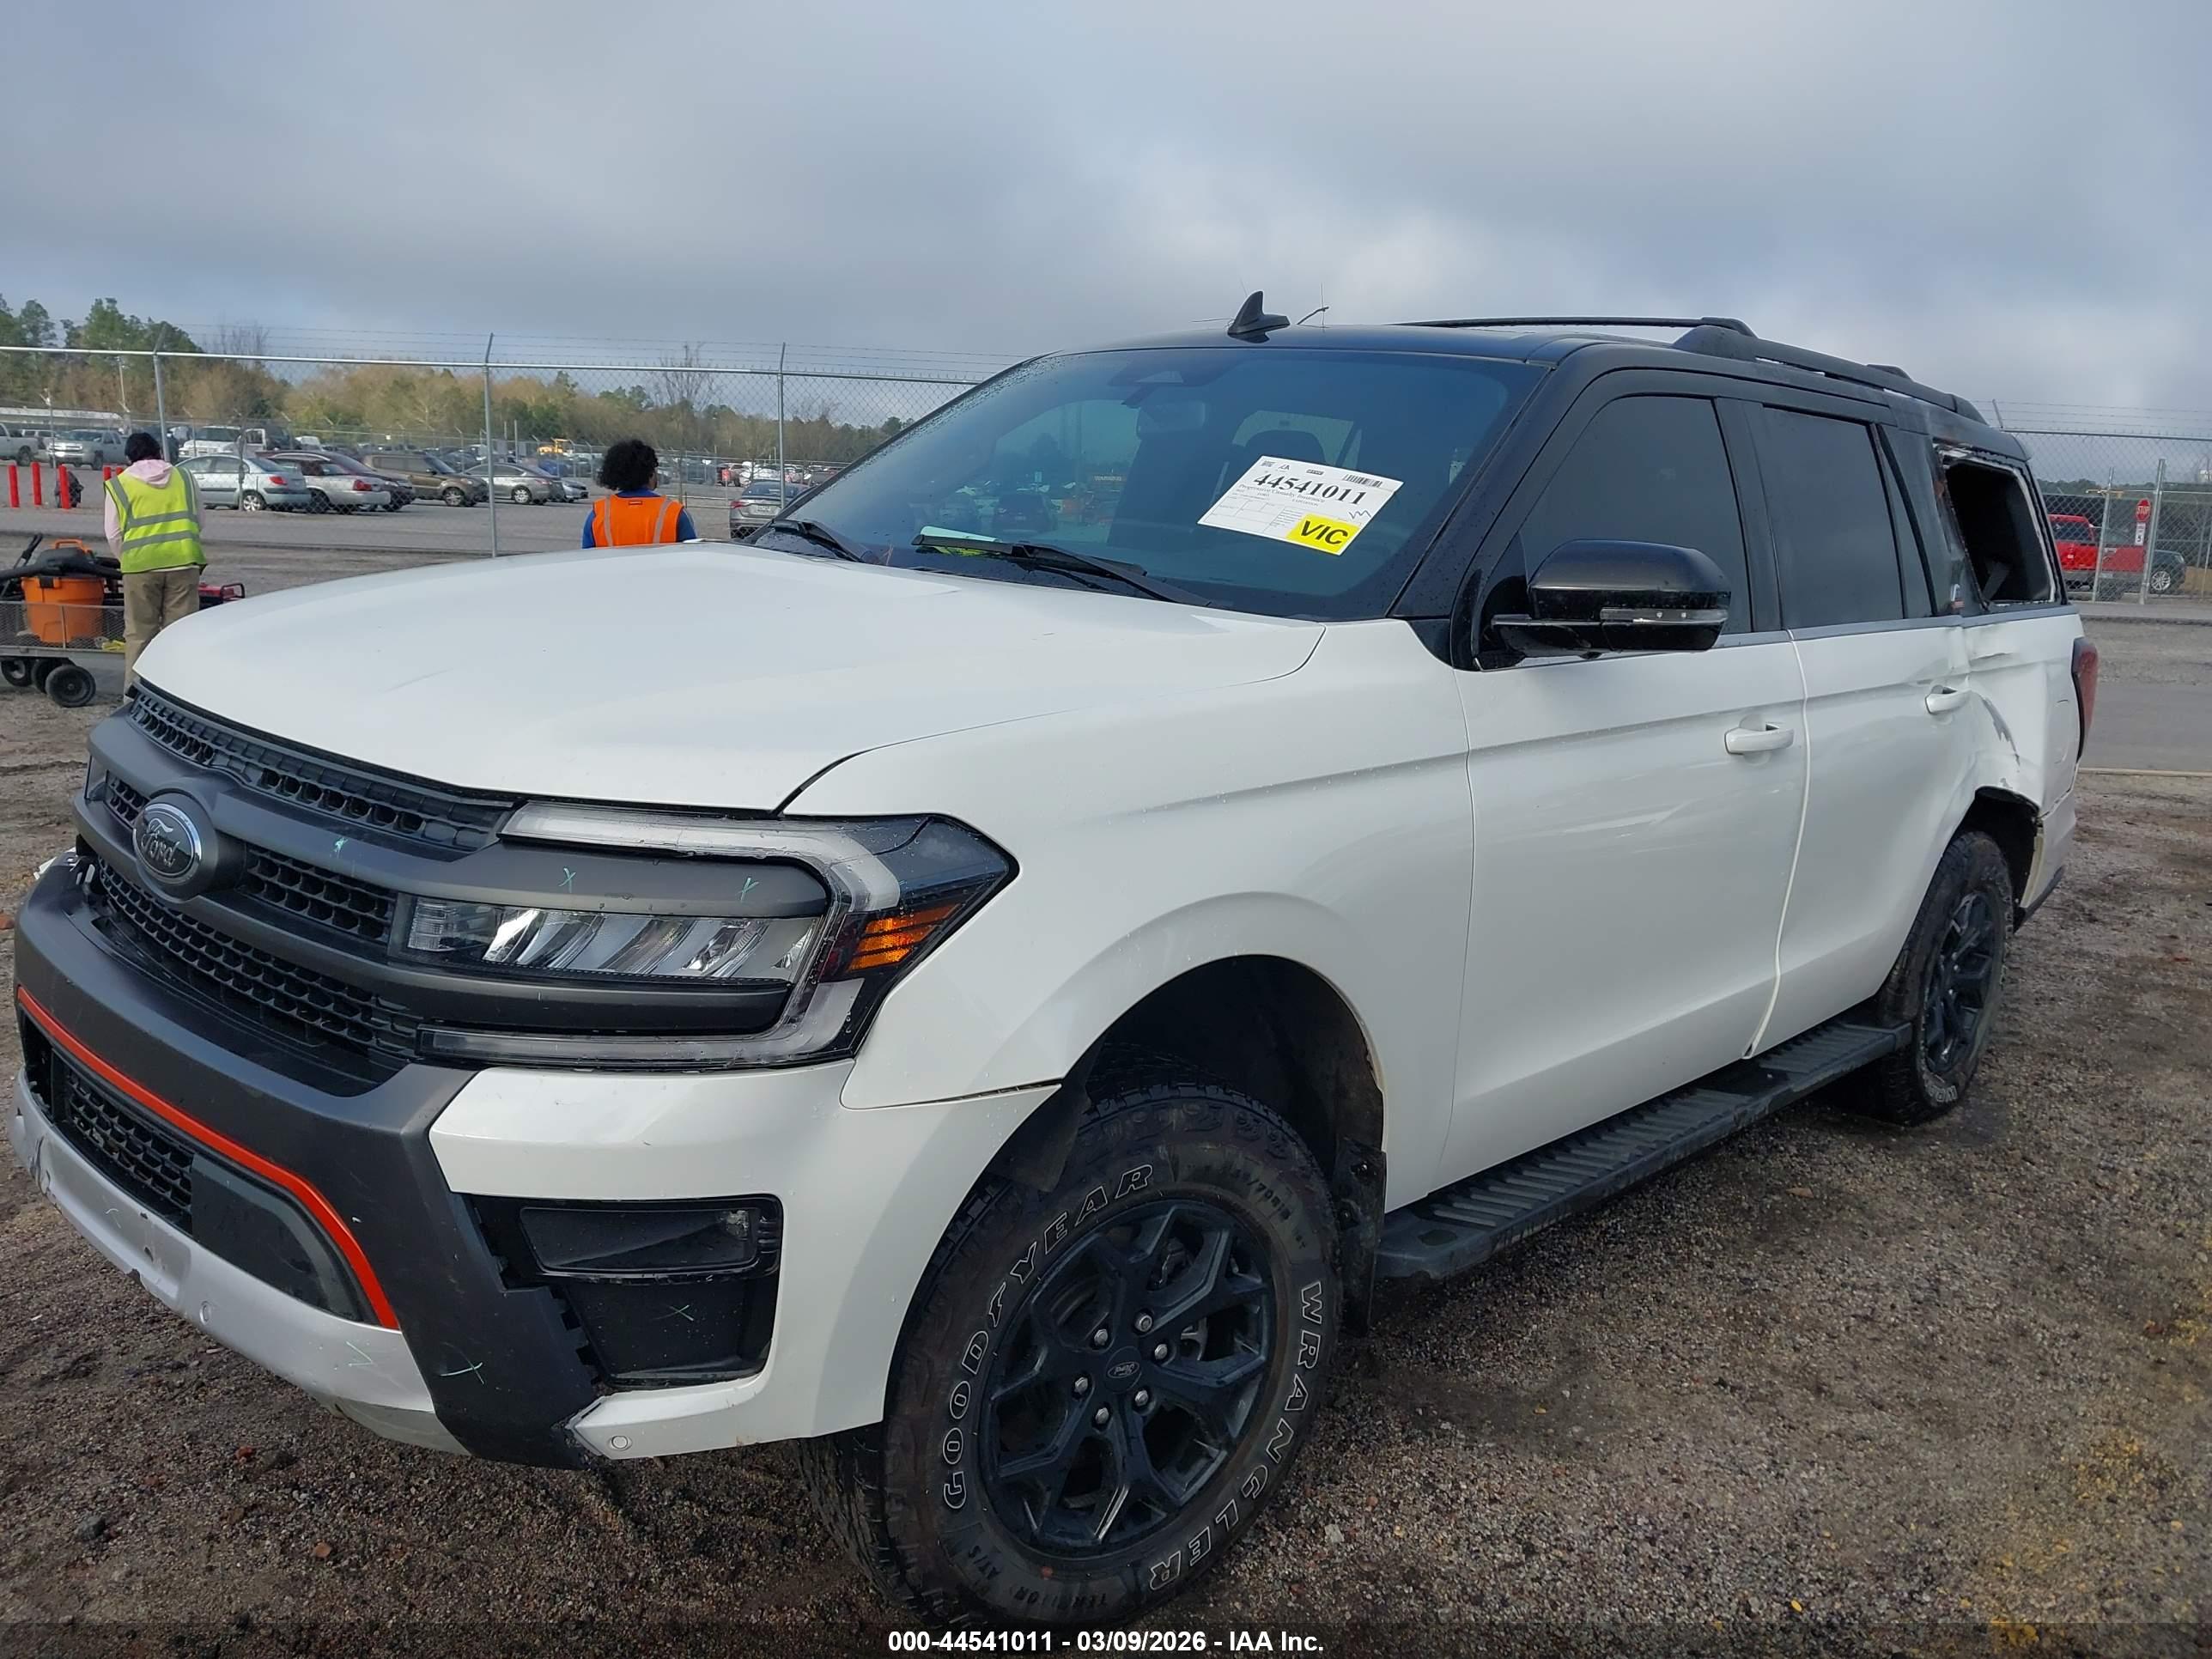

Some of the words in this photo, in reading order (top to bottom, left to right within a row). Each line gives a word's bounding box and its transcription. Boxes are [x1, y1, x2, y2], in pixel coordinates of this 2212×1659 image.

[1253, 473, 1367, 505] 44541011
[2137, 505, 2150, 515] STOP
[1300, 520, 1349, 544] VIC
[141, 817, 180, 868] Ford
[943, 1164, 1153, 1510] GOODYEAR
[1149, 1280, 1323, 1591] WRANGLER
